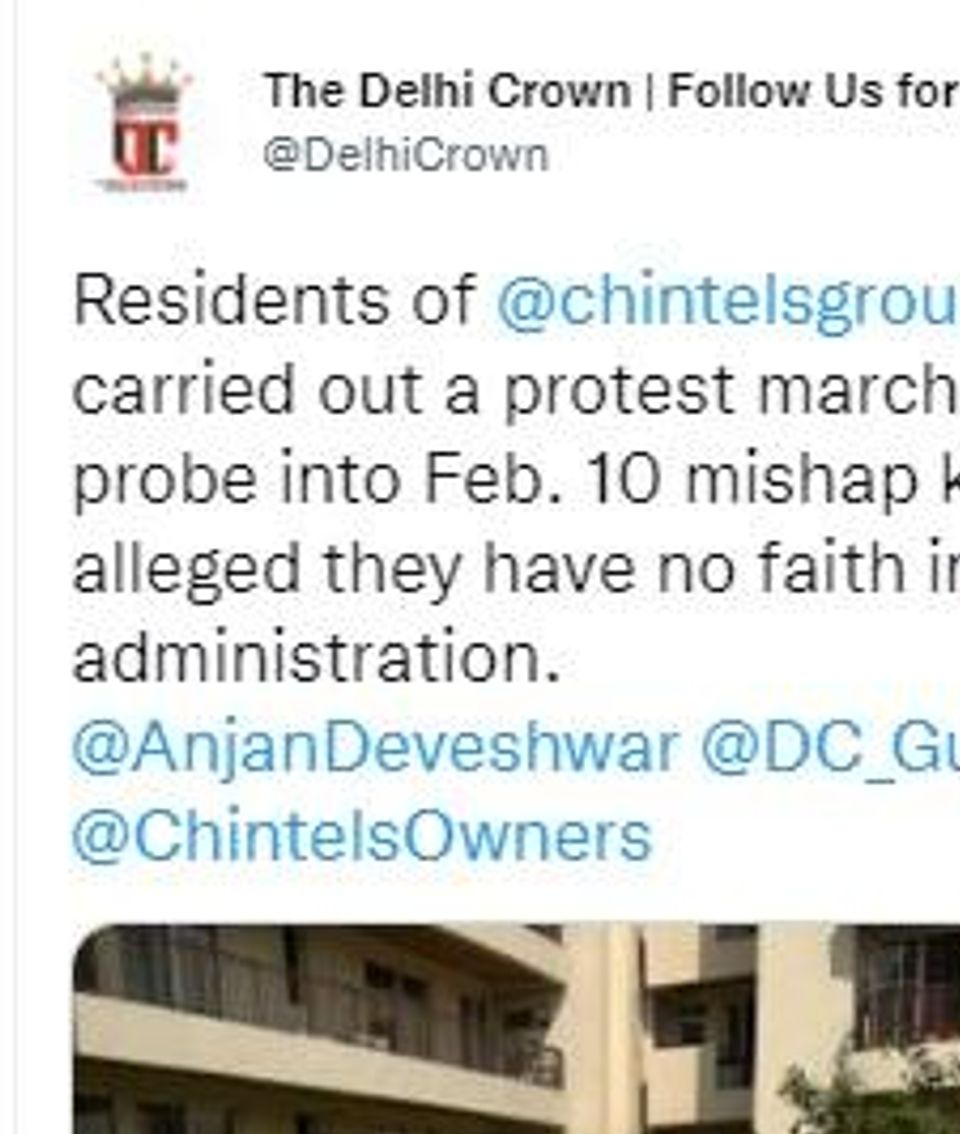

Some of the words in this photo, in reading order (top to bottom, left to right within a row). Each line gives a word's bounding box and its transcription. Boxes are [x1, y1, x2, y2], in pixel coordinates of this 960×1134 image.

[263, 72, 344, 108] The
[361, 69, 472, 108] Delhi
[489, 72, 630, 108] Crown
[670, 72, 811, 108] Follow
[826, 73, 883, 108] Us
[896, 72, 959, 108] for
[264, 136, 547, 172] @DelhiCrown
[76, 268, 390, 326] Residents
[413, 272, 477, 326] of
[73, 358, 294, 415] carried
[320, 367, 423, 415] out
[446, 374, 480, 415] a
[507, 366, 735, 426] protest
[761, 363, 956, 415] march
[75, 451, 257, 516] probe
[281, 447, 401, 505] into
[428, 451, 561, 505] Feb.
[588, 451, 661, 505] 10
[688, 447, 918, 517] mishap
[73, 541, 300, 607] alleged
[322, 541, 463, 607] they
[486, 541, 636, 594] have
[660, 553, 735, 594] no
[758, 536, 905, 594] faith
[73, 625, 559, 683] administration.
[73, 716, 680, 785] @AnjanDeveshwar
[73, 804, 651, 866] @ChintelsOwners
